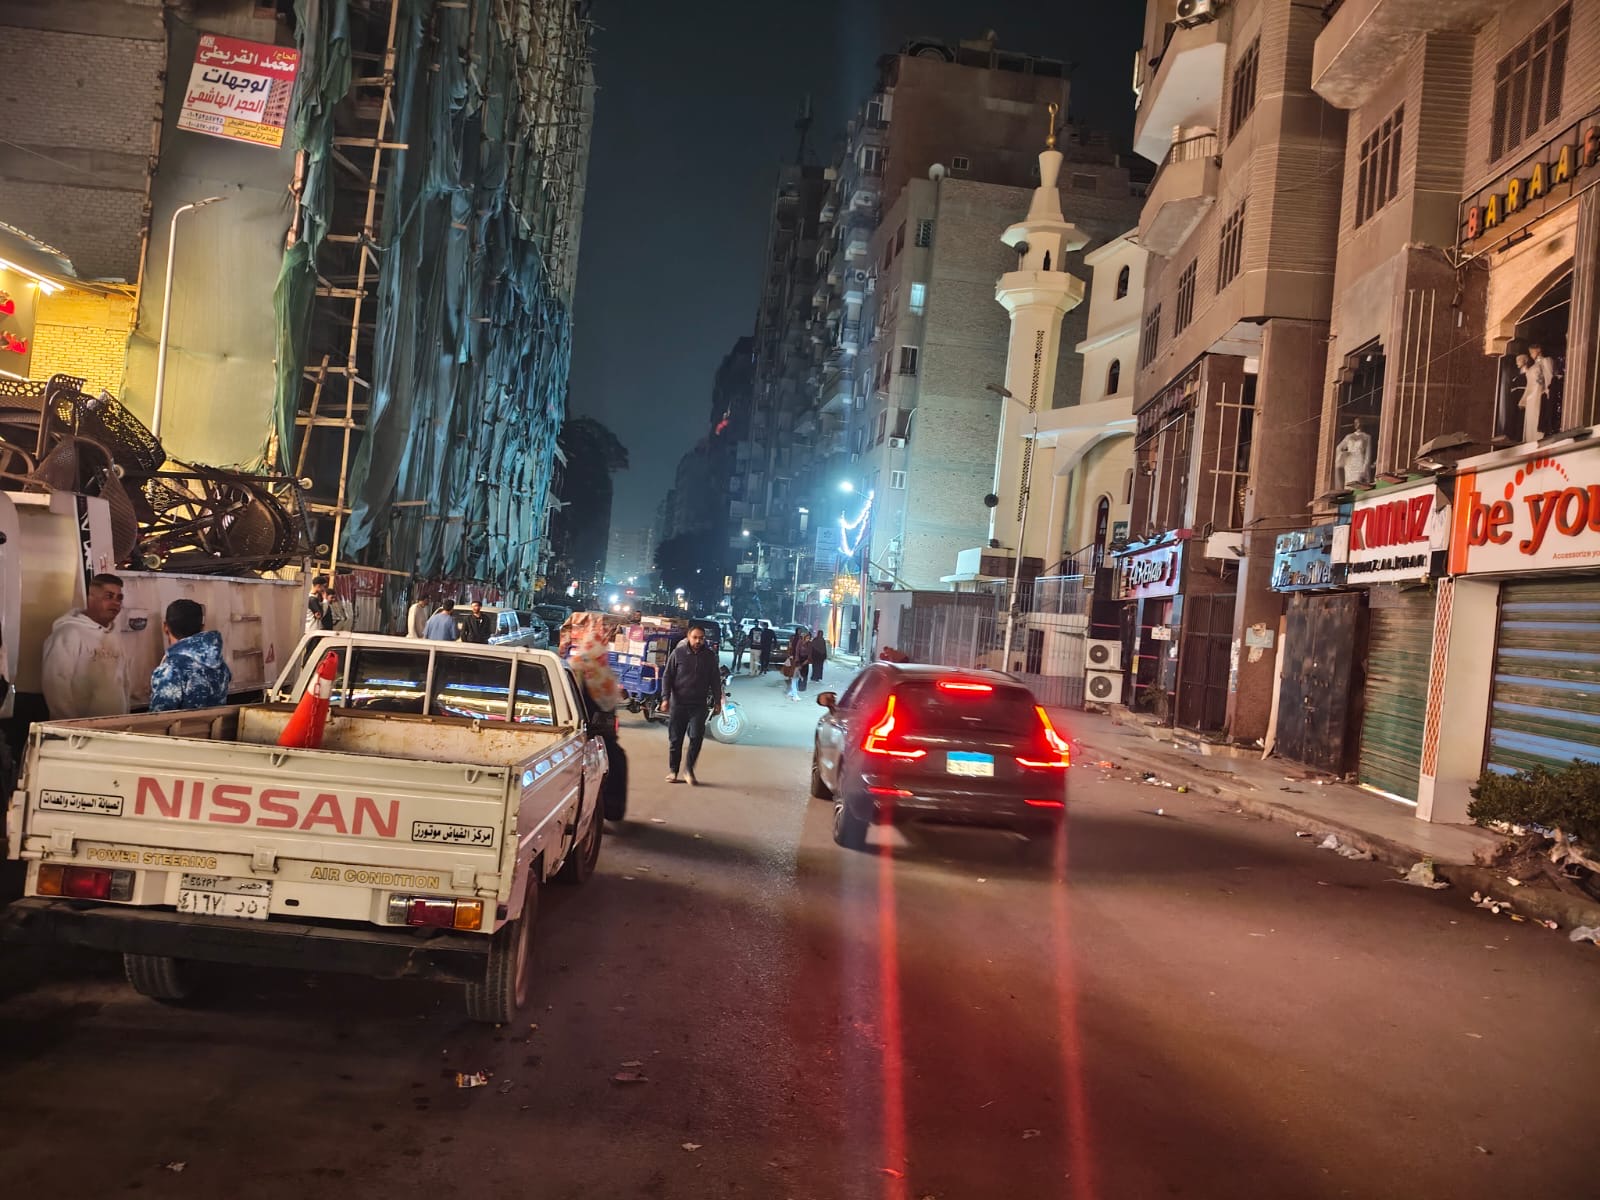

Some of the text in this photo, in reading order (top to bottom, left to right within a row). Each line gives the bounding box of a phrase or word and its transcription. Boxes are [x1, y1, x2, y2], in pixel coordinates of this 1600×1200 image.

[260, 57, 295, 72] محمد
[202, 68, 268, 93] لوجهات
[187, 88, 265, 114] الحجر الهاشمي
[1468, 491, 1514, 546] be
[43, 792, 120, 813] لصيانة السيارات والمعدات
[134, 777, 400, 838] NISSAN
[414, 824, 490, 843] مركز الفياض موتورز
[87, 847, 217, 870] POWER STEERING
[190, 877, 218, 888] EGYPT
[237, 882, 263, 890] مصر
[310, 866, 440, 889] AIR CONDITION
